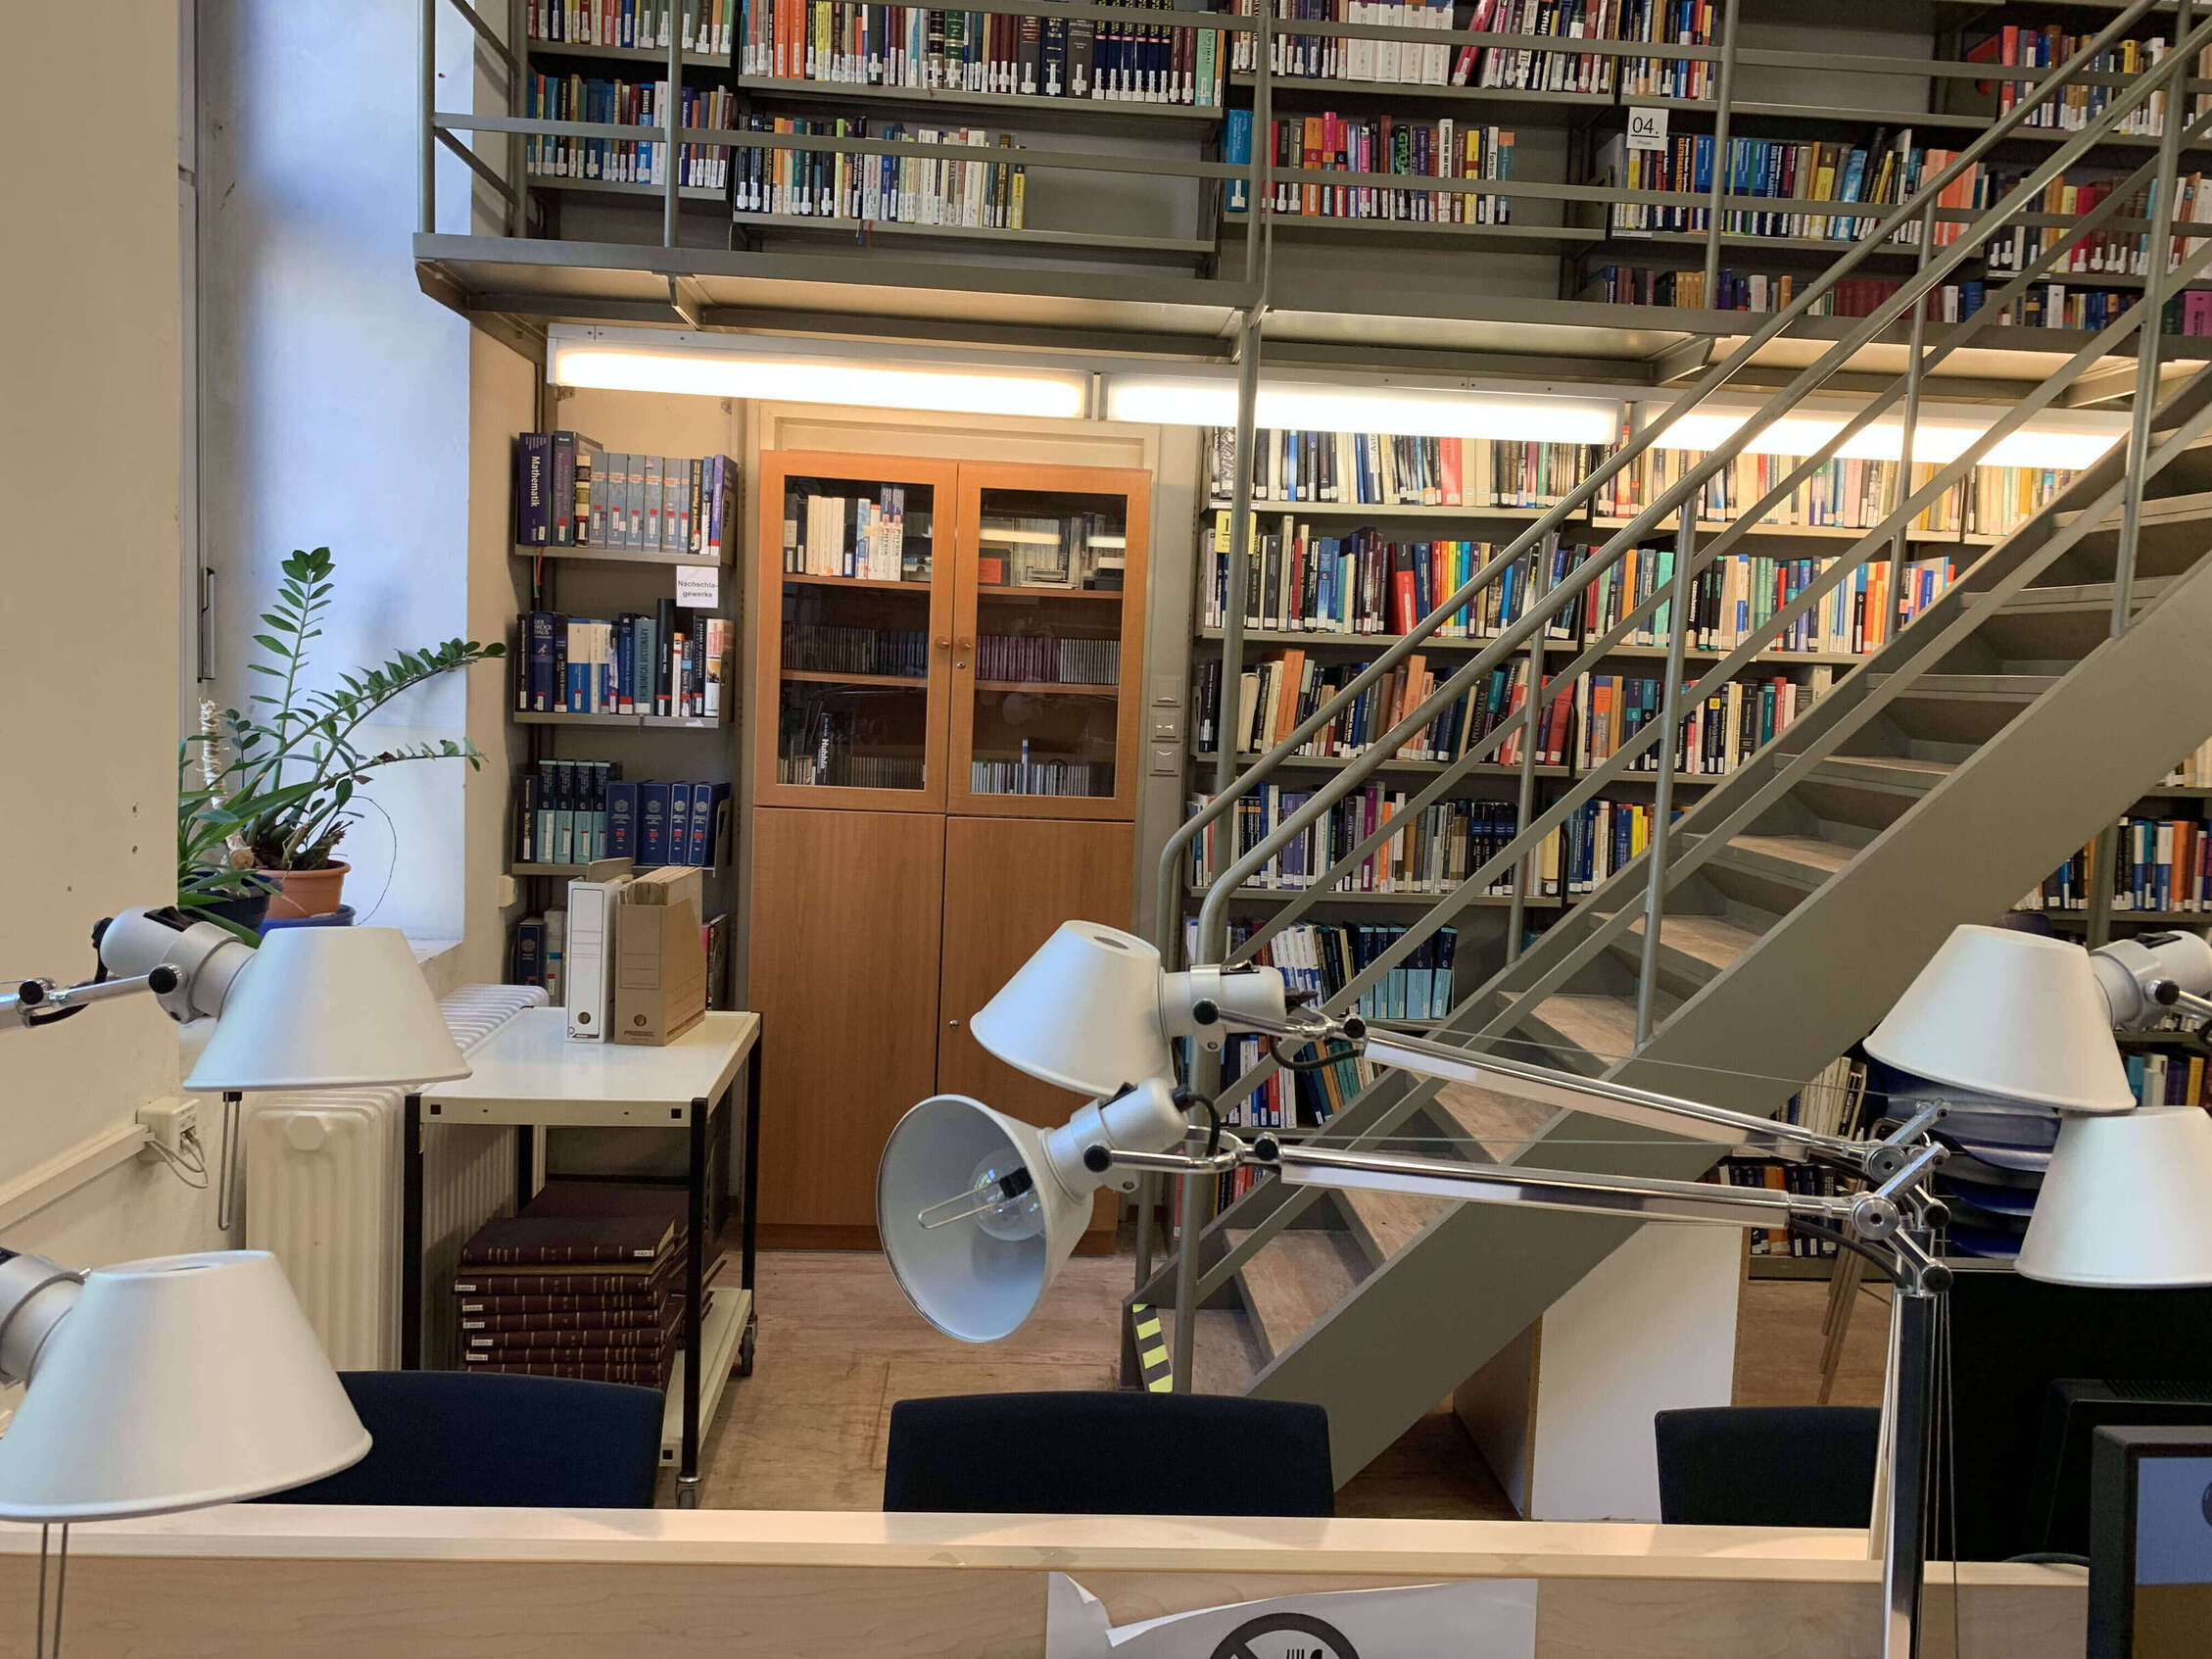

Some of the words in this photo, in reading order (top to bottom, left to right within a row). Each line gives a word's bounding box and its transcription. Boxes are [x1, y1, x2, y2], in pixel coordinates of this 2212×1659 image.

[1632, 117, 1659, 135] 04.
[530, 455, 542, 508] Mathematik
[683, 590, 713, 599] gewerke
[820, 738, 830, 769] Hubble
